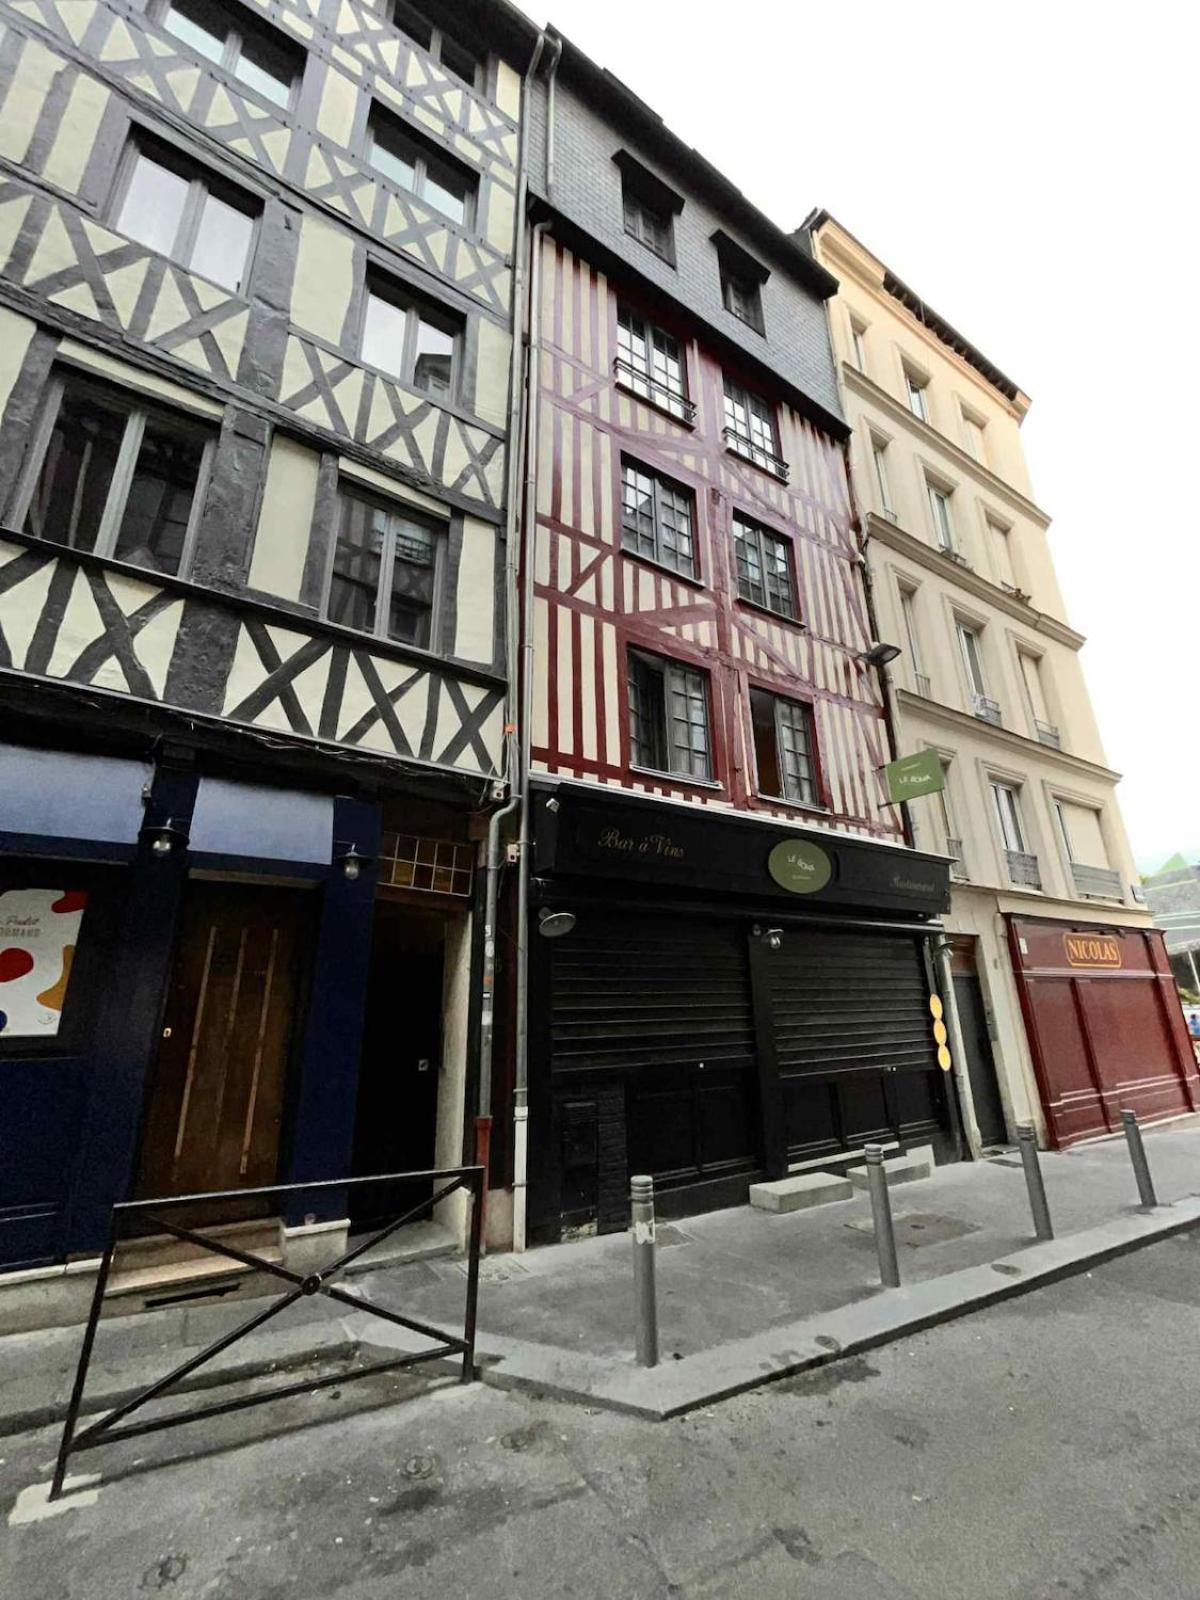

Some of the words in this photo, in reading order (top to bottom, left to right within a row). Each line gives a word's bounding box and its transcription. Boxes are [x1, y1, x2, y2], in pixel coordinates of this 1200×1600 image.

[597, 826, 635, 850] Bar
[651, 834, 685, 857] Vins
[1068, 939, 1118, 960] NICOLAS
